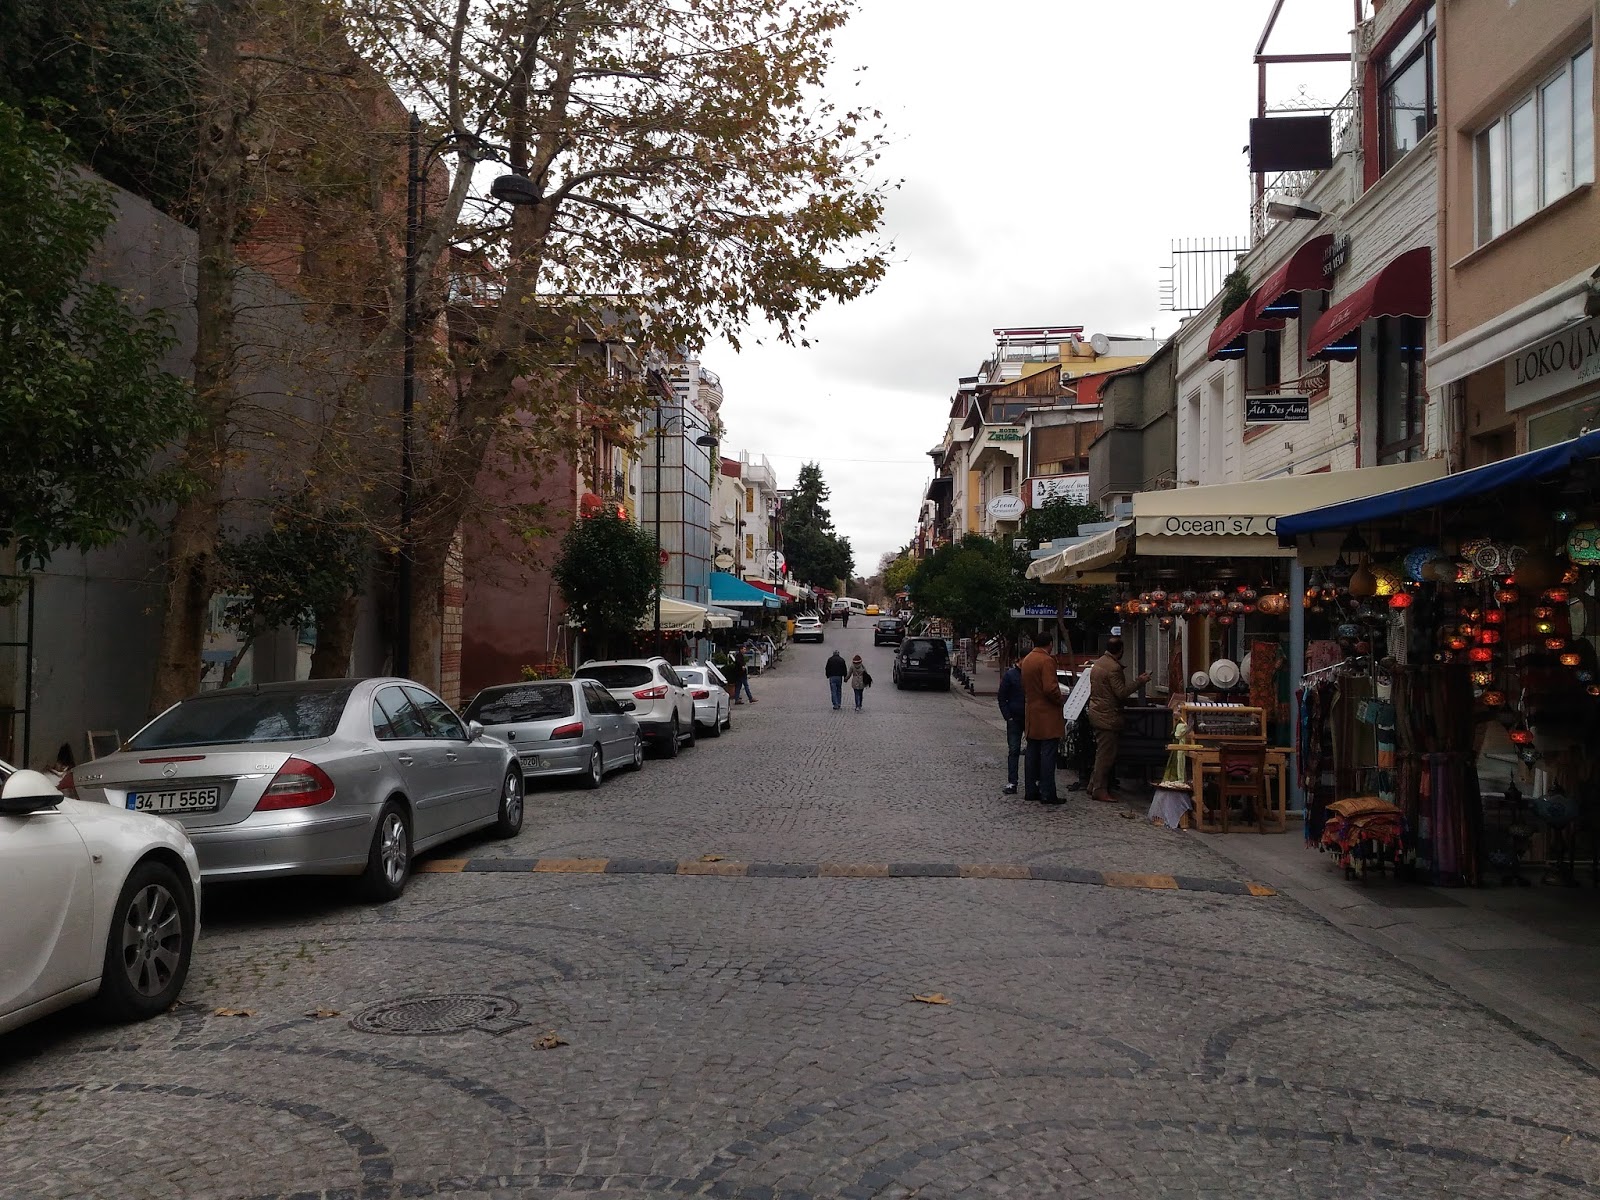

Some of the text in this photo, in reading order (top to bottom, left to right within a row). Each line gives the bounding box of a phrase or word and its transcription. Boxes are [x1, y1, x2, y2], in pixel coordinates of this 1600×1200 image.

[1248, 404, 1308, 416] Ala Des Amis
[992, 499, 1018, 509] Seoul
[660, 621, 696, 629] estaurant
[136, 790, 216, 810] 34 TT 5565
